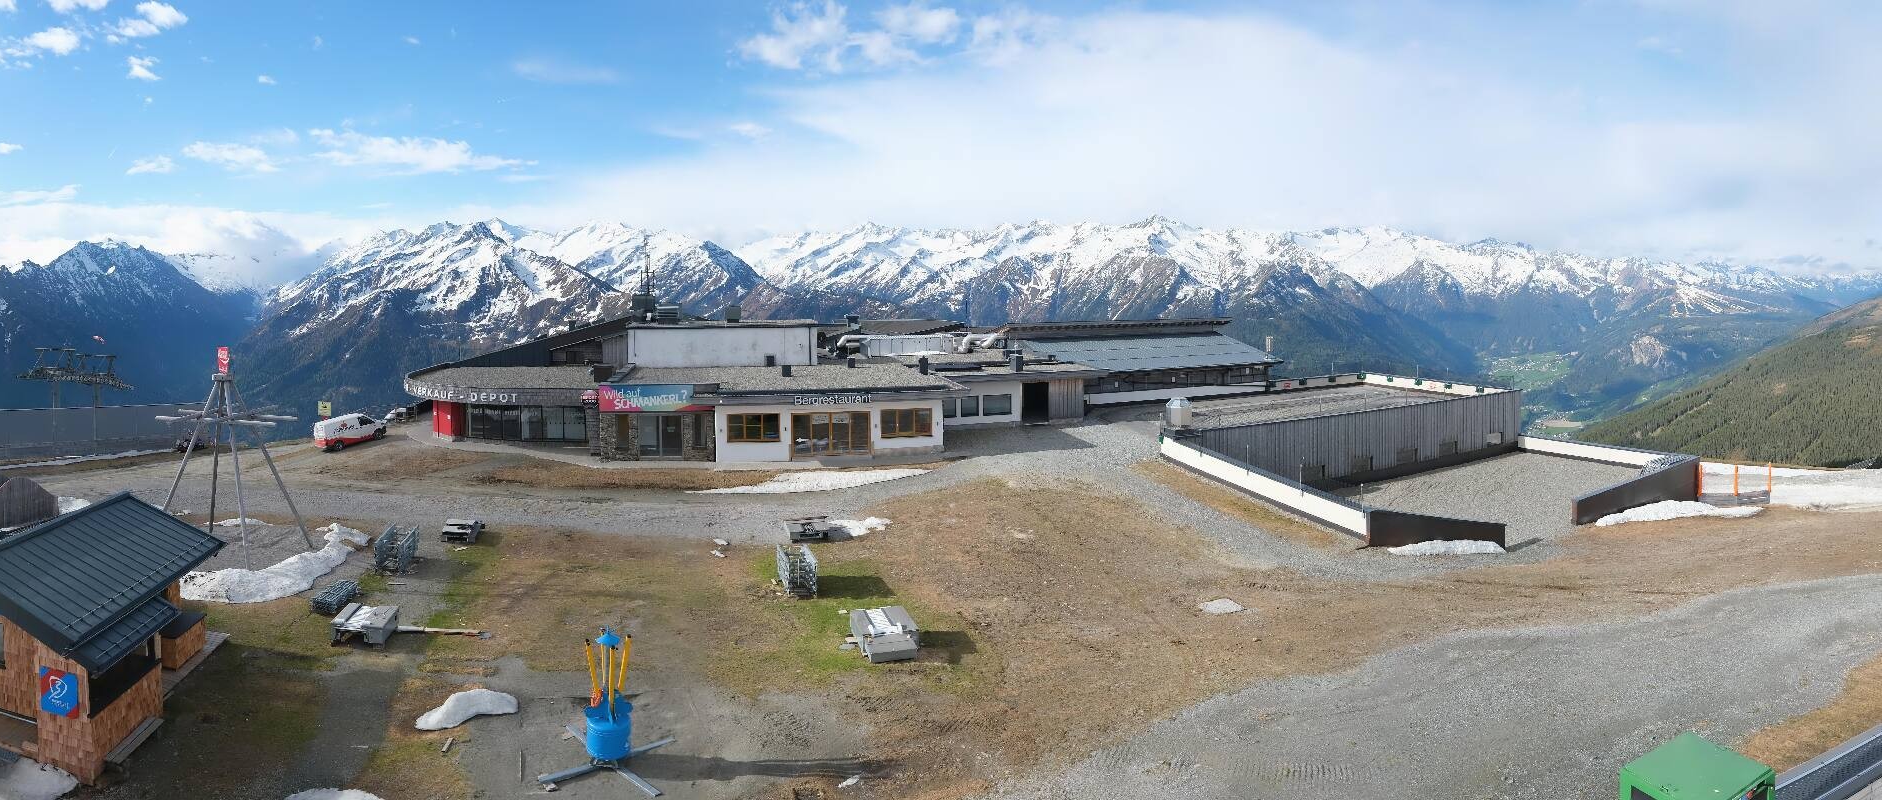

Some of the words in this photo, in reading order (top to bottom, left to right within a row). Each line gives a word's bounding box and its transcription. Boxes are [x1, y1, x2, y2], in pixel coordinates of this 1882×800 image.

[414, 386, 454, 400] VERKAUF
[470, 392, 518, 403] DEPOT
[603, 388, 624, 399] Wild
[626, 387, 641, 399] auf
[614, 389, 688, 410] SCHMANKERL?
[794, 393, 872, 406] Bergrestaurant
